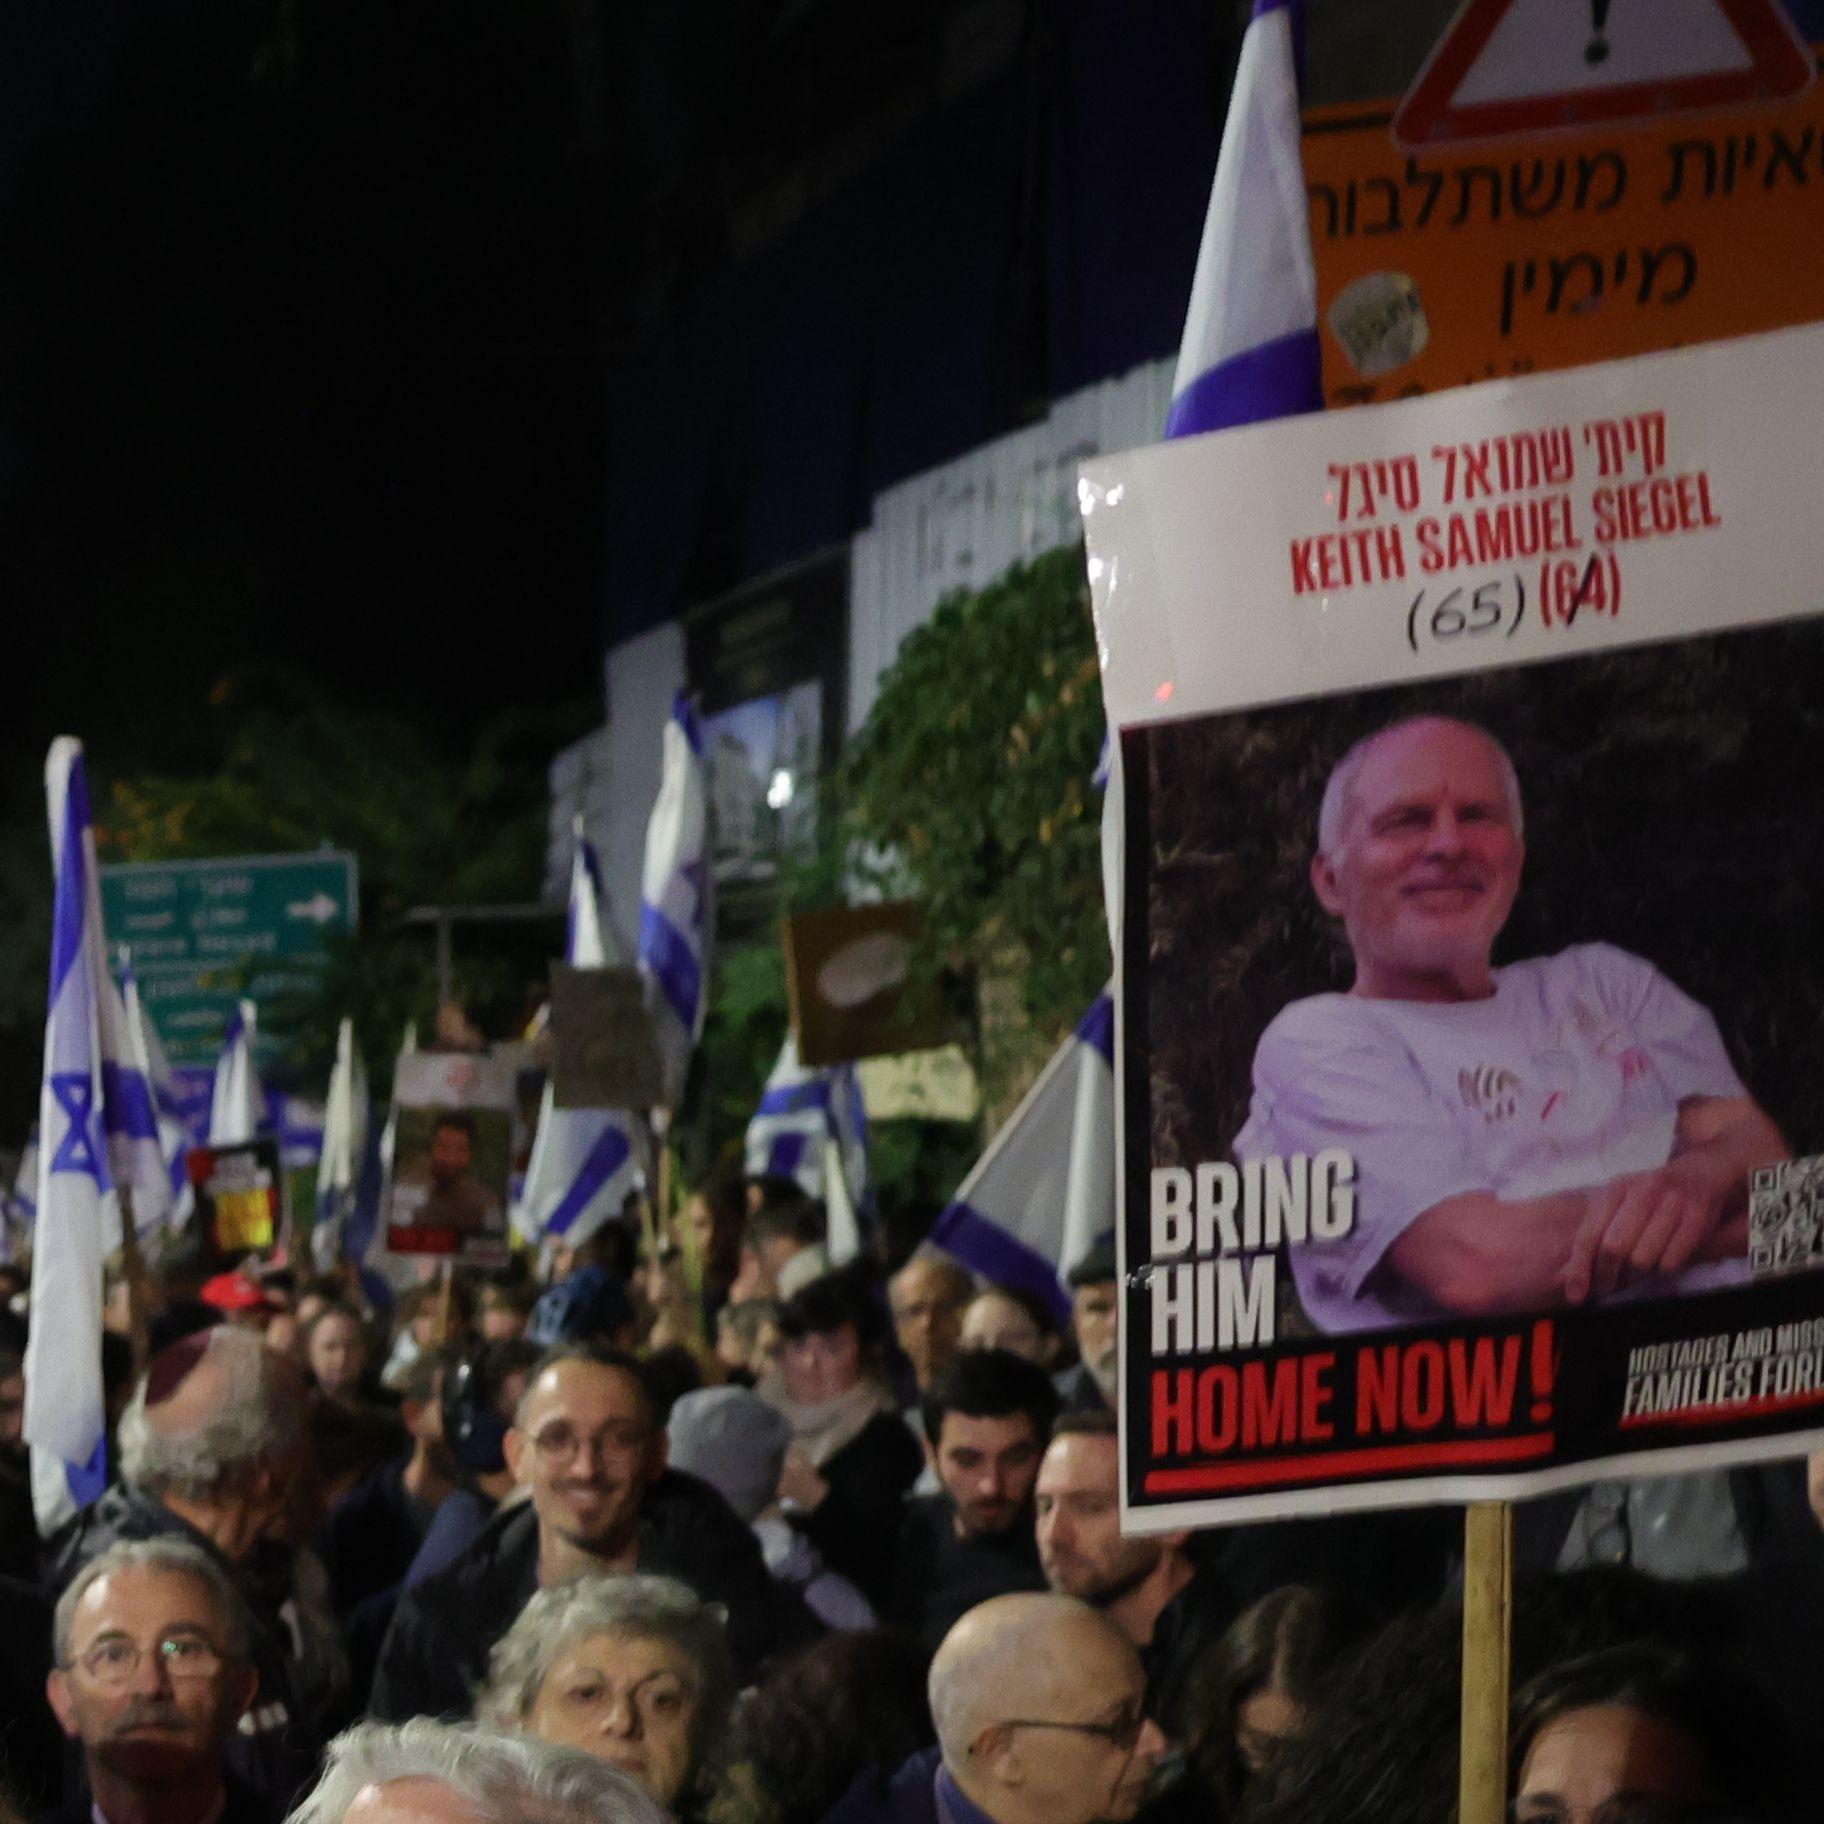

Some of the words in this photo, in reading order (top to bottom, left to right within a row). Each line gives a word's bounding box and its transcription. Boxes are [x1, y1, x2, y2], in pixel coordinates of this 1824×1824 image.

[1661, 127, 1824, 204] איות
[1498, 242, 1698, 337] מימין
[1326, 454, 1421, 522] סיגל
[1431, 424, 1575, 504] שמואל
[1290, 524, 1406, 596] KEITH
[1416, 494, 1583, 576] SAMUEL
[1592, 470, 1722, 545] SIEGEL
[1407, 573, 1526, 654] (65)
[1151, 1148, 1356, 1259] BRING
[1150, 1254, 1277, 1358] HIM
[1731, 1327, 1773, 1361] AND
[1151, 1351, 1336, 1458] HOME
[1355, 1317, 1557, 1437] NOW!
[1622, 1359, 1752, 1422] FAMILIES
